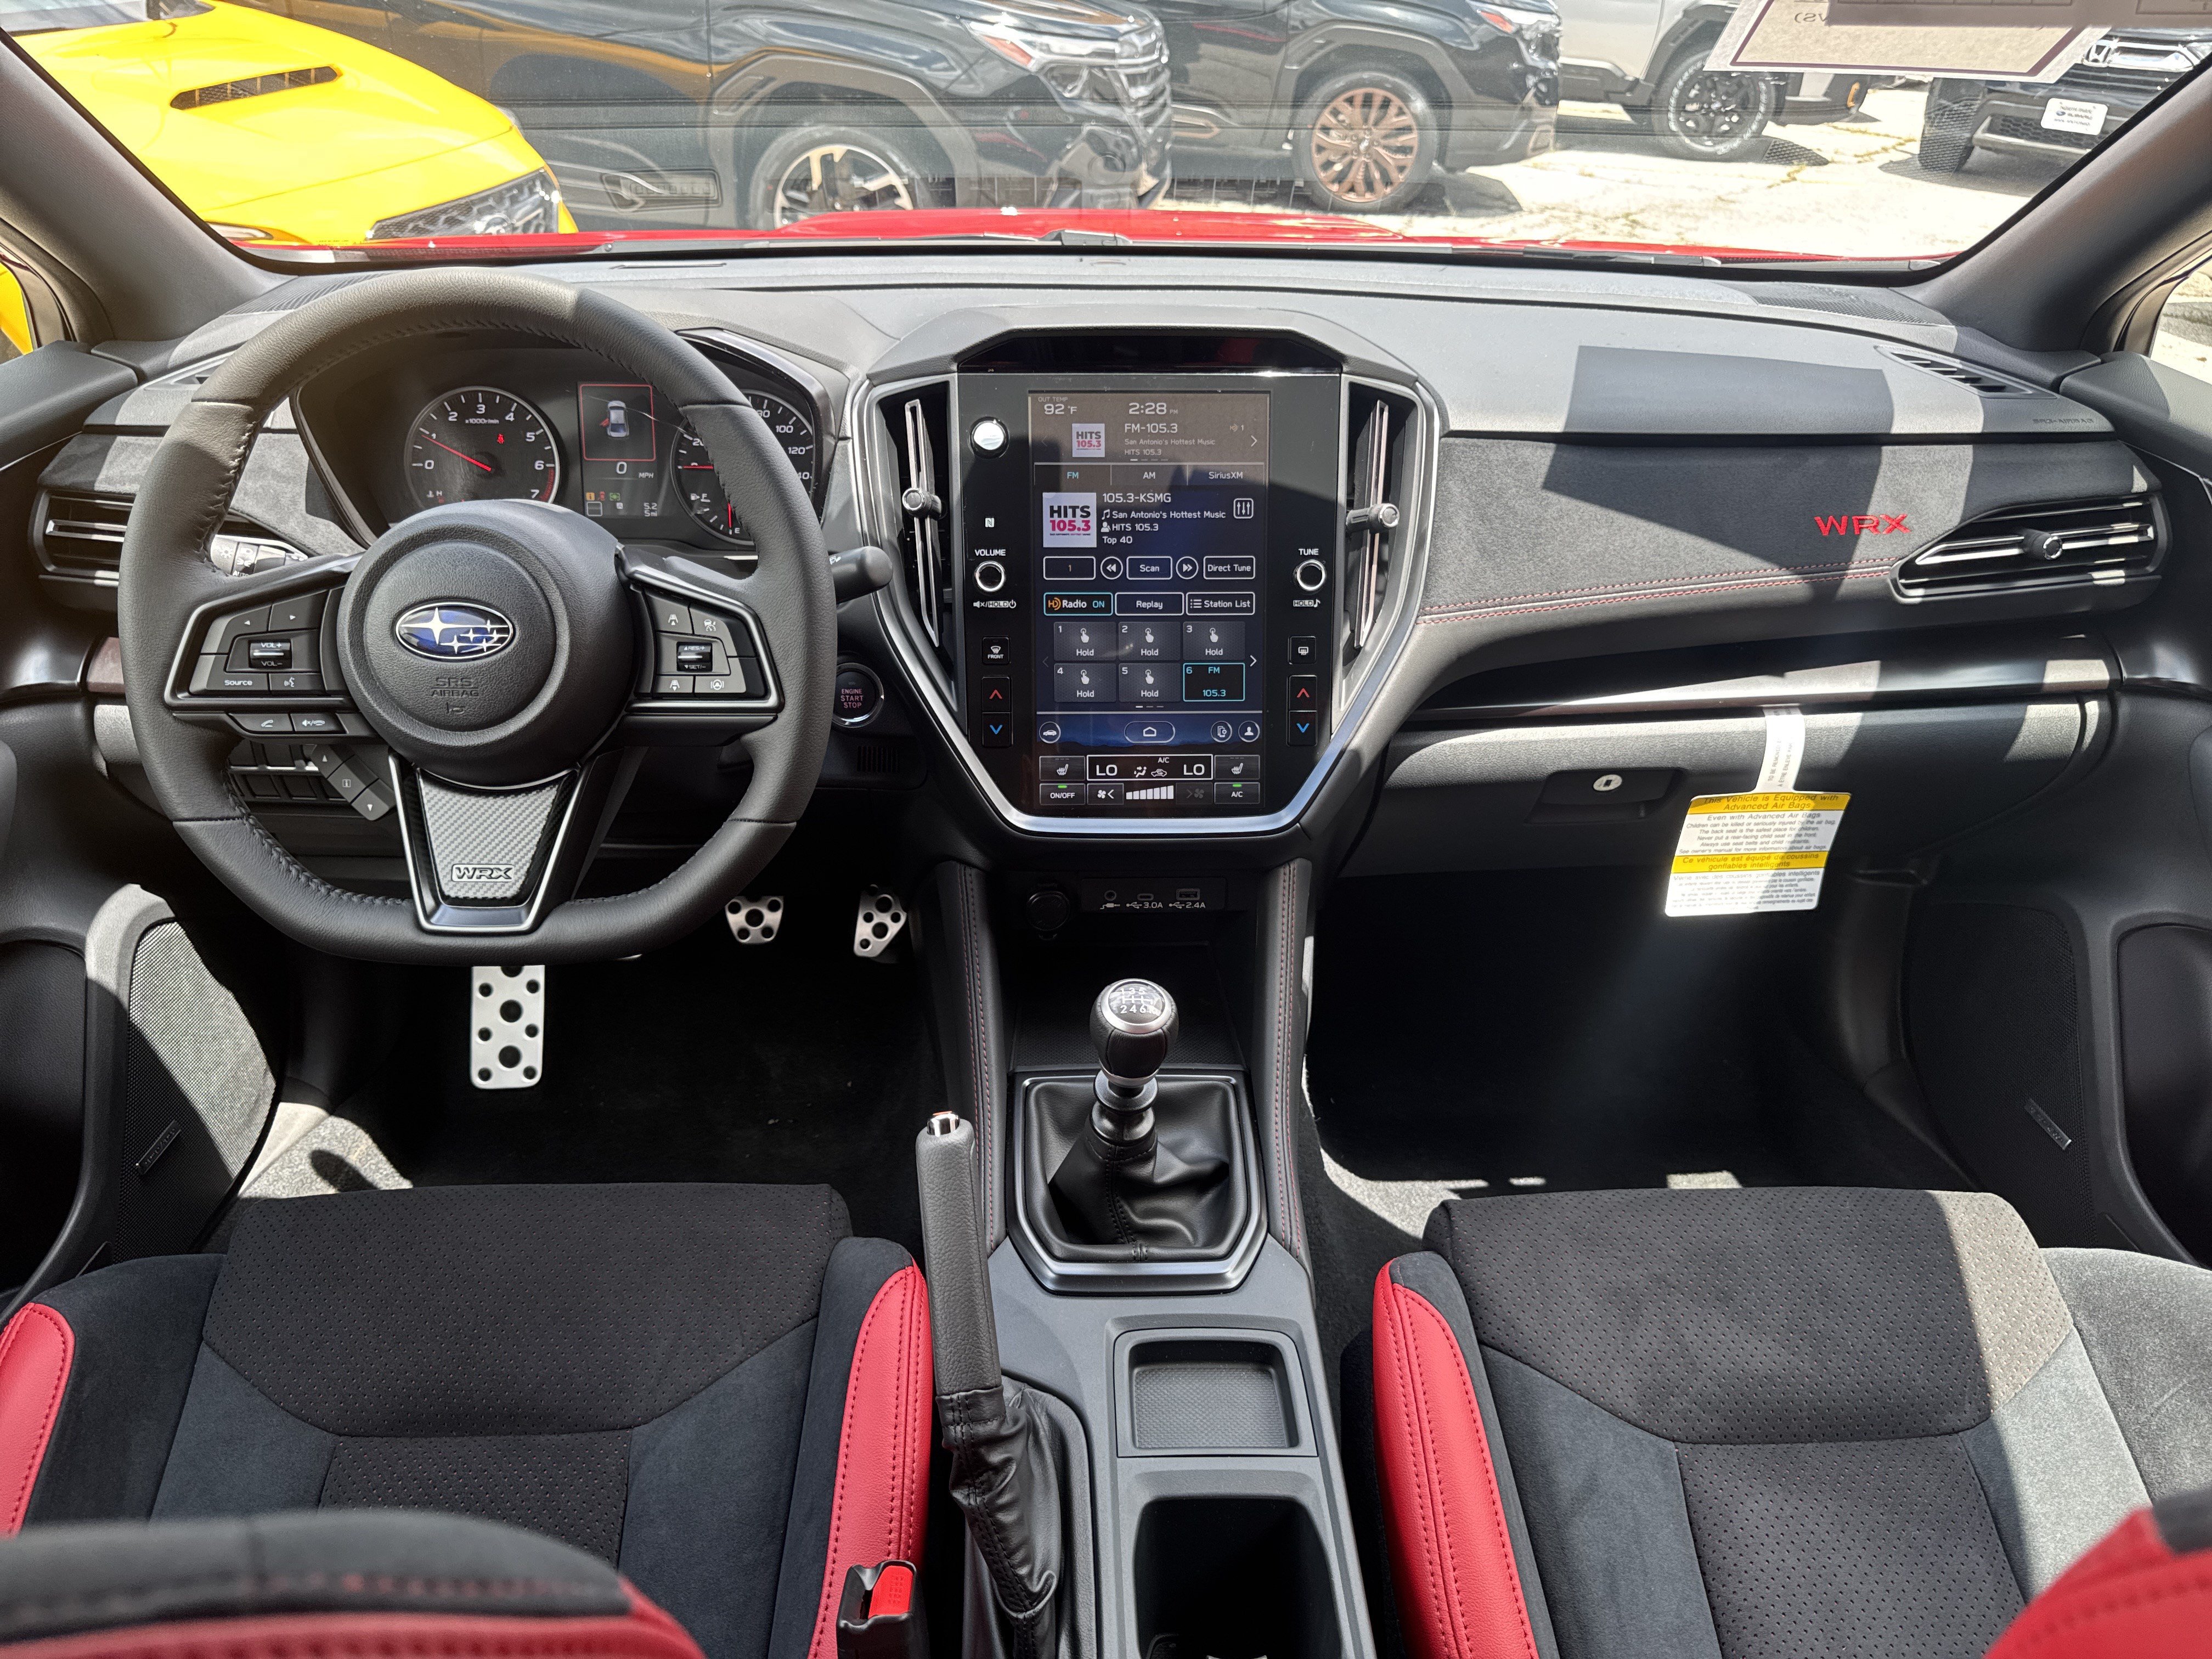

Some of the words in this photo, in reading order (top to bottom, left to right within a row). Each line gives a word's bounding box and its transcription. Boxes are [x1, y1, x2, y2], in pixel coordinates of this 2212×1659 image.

[476, 404, 486, 414] 3
[1044, 403, 1065, 415] 92
[1128, 402, 1167, 415] 2:28
[448, 413, 458, 421] 2
[505, 413, 515, 421] 4
[776, 425, 794, 433] 100
[1125, 423, 1178, 433] FM-105.3
[526, 433, 535, 442] 5
[1076, 431, 1102, 439] HITS
[788, 446, 806, 455] 120
[424, 460, 435, 470] 0
[534, 460, 544, 470] 6
[616, 461, 627, 475] 0
[1209, 471, 1243, 479] SiriusXM
[531, 489, 540, 498] 7
[1102, 493, 1171, 503] 105.3-KSMG
[1049, 505, 1091, 518] HITS
[1049, 520, 1091, 532] 105.3
[1135, 523, 1159, 531] 105.3
[1814, 514, 1911, 537] WRX
[1102, 536, 1117, 545] Top
[1139, 564, 1160, 572] Scan
[1207, 564, 1231, 572] Direct
[1233, 564, 1251, 572] Tune
[1062, 599, 1087, 608] Radio
[1092, 600, 1105, 608] ON
[1136, 600, 1163, 610] Replay
[1204, 600, 1233, 608] Station
[1235, 600, 1251, 608] List
[1186, 625, 1193, 633] 3
[1121, 667, 1128, 675] 5
[436, 678, 475, 687] SRS
[1203, 689, 1226, 697] 105.3
[1096, 764, 1118, 776] LO
[1183, 764, 1205, 776] LO
[1726, 794, 1758, 803] Vehicle
[1773, 793, 1817, 802] Equipped
[1723, 803, 1769, 811] Advanced
[1788, 802, 1812, 810] Bags
[1708, 863, 1747, 871] gonflables
[455, 867, 513, 879] WRX
[1120, 1005, 1127, 1014] 2
[1130, 1005, 1137, 1013] 4
[1139, 1005, 1147, 1013] 6
